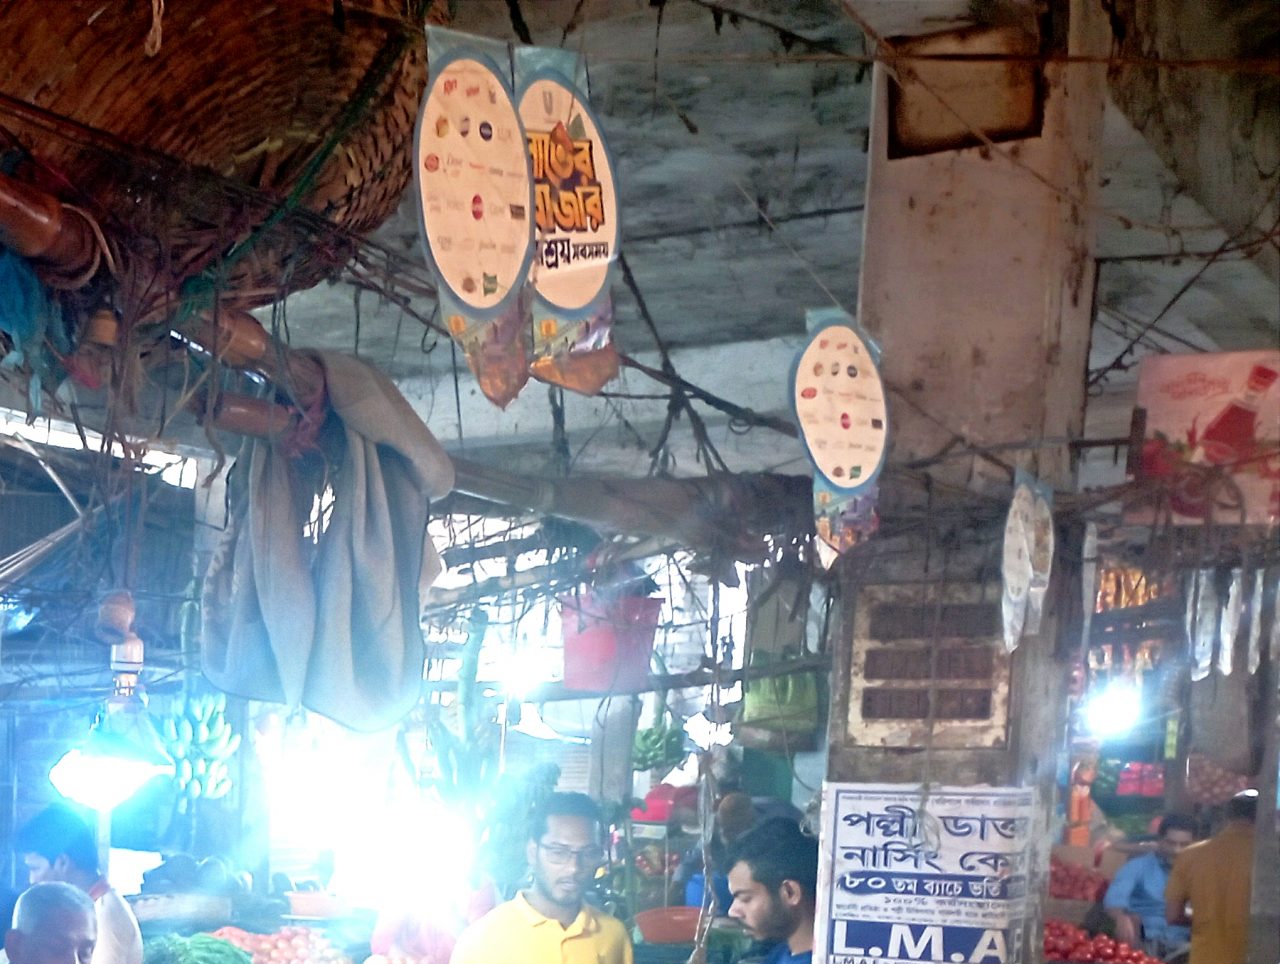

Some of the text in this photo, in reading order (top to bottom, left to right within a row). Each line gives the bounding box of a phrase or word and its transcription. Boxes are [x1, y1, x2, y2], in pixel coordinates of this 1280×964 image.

[843, 805, 920, 837] পল্লী
[845, 875, 887, 889] ৮০
[892, 877, 919, 893] তম
